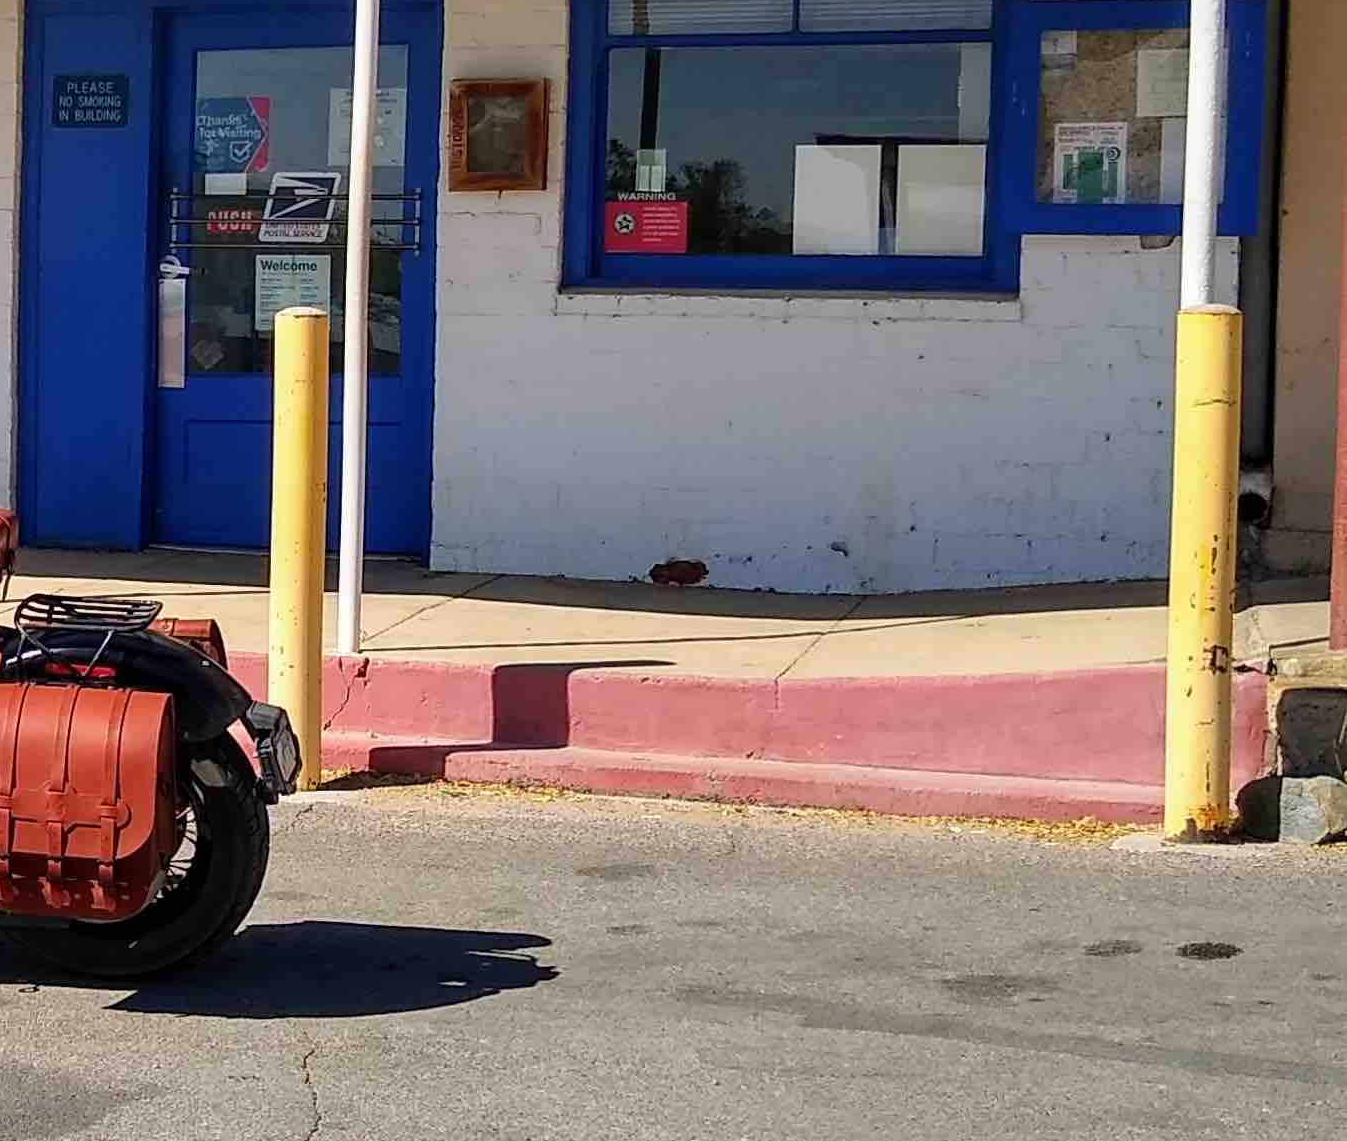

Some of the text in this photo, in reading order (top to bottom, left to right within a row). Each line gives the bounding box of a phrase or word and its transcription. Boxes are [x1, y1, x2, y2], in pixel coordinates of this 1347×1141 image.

[67, 81, 114, 94] PLEASE
[59, 95, 121, 108] NO SMOKING
[59, 109, 121, 122] IN BUILDING
[617, 191, 677, 202] WARNING
[260, 259, 317, 272] Welcome
